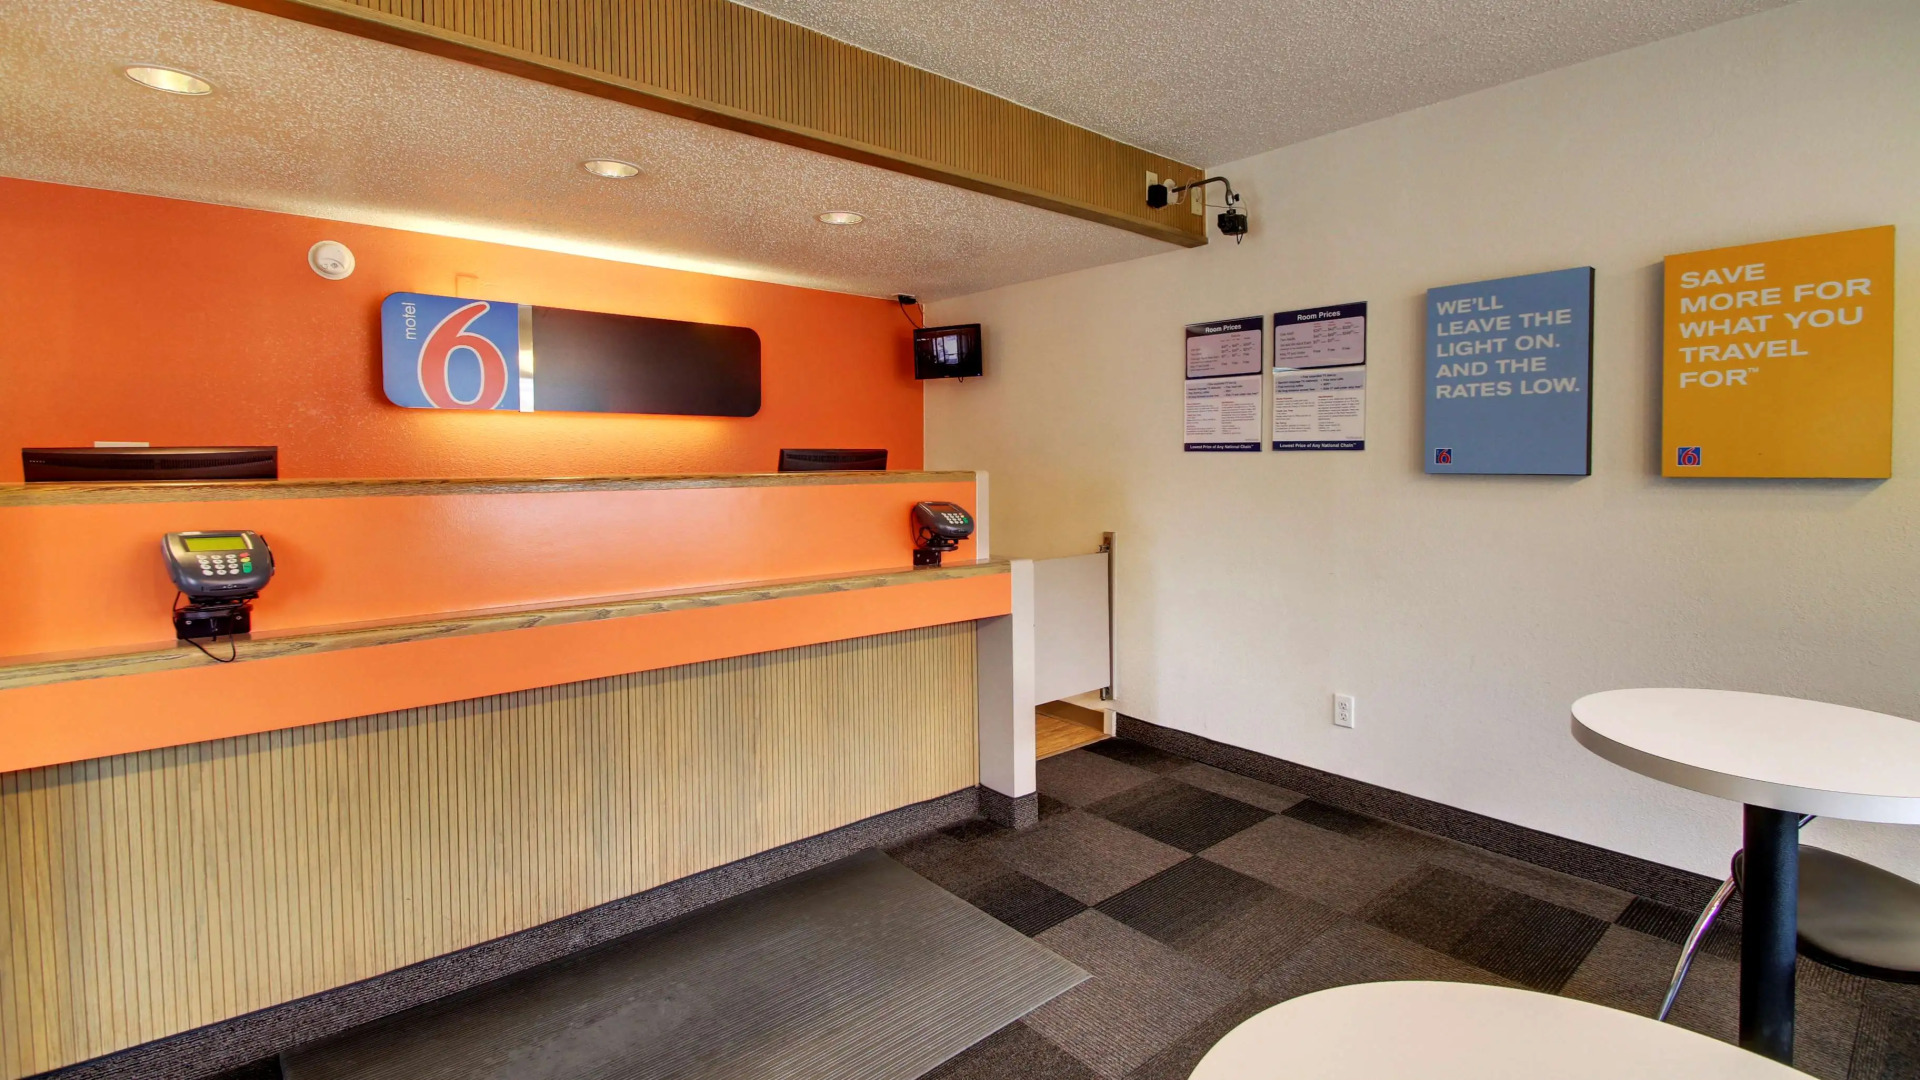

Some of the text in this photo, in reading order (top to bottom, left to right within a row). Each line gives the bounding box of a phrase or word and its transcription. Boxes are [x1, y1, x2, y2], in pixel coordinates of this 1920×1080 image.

[1680, 263, 1765, 289] SAVE
[1436, 295, 1504, 316] WE'LL
[1680, 278, 1872, 314] MORE FOR
[401, 302, 417, 340] motel
[1297, 310, 1341, 321] Room Prices
[1437, 309, 1572, 337] LEAVE THE
[1679, 306, 1864, 339] WHAT YOU
[417, 301, 508, 410] 6
[1436, 333, 1561, 358] LIGHT ON.
[1679, 339, 1809, 363] TRAVEL
[1435, 357, 1547, 378] AND THE
[1436, 377, 1580, 399] RATES LOW.
[1438, 449, 1451, 464] 6
[1681, 447, 1698, 465] 6
